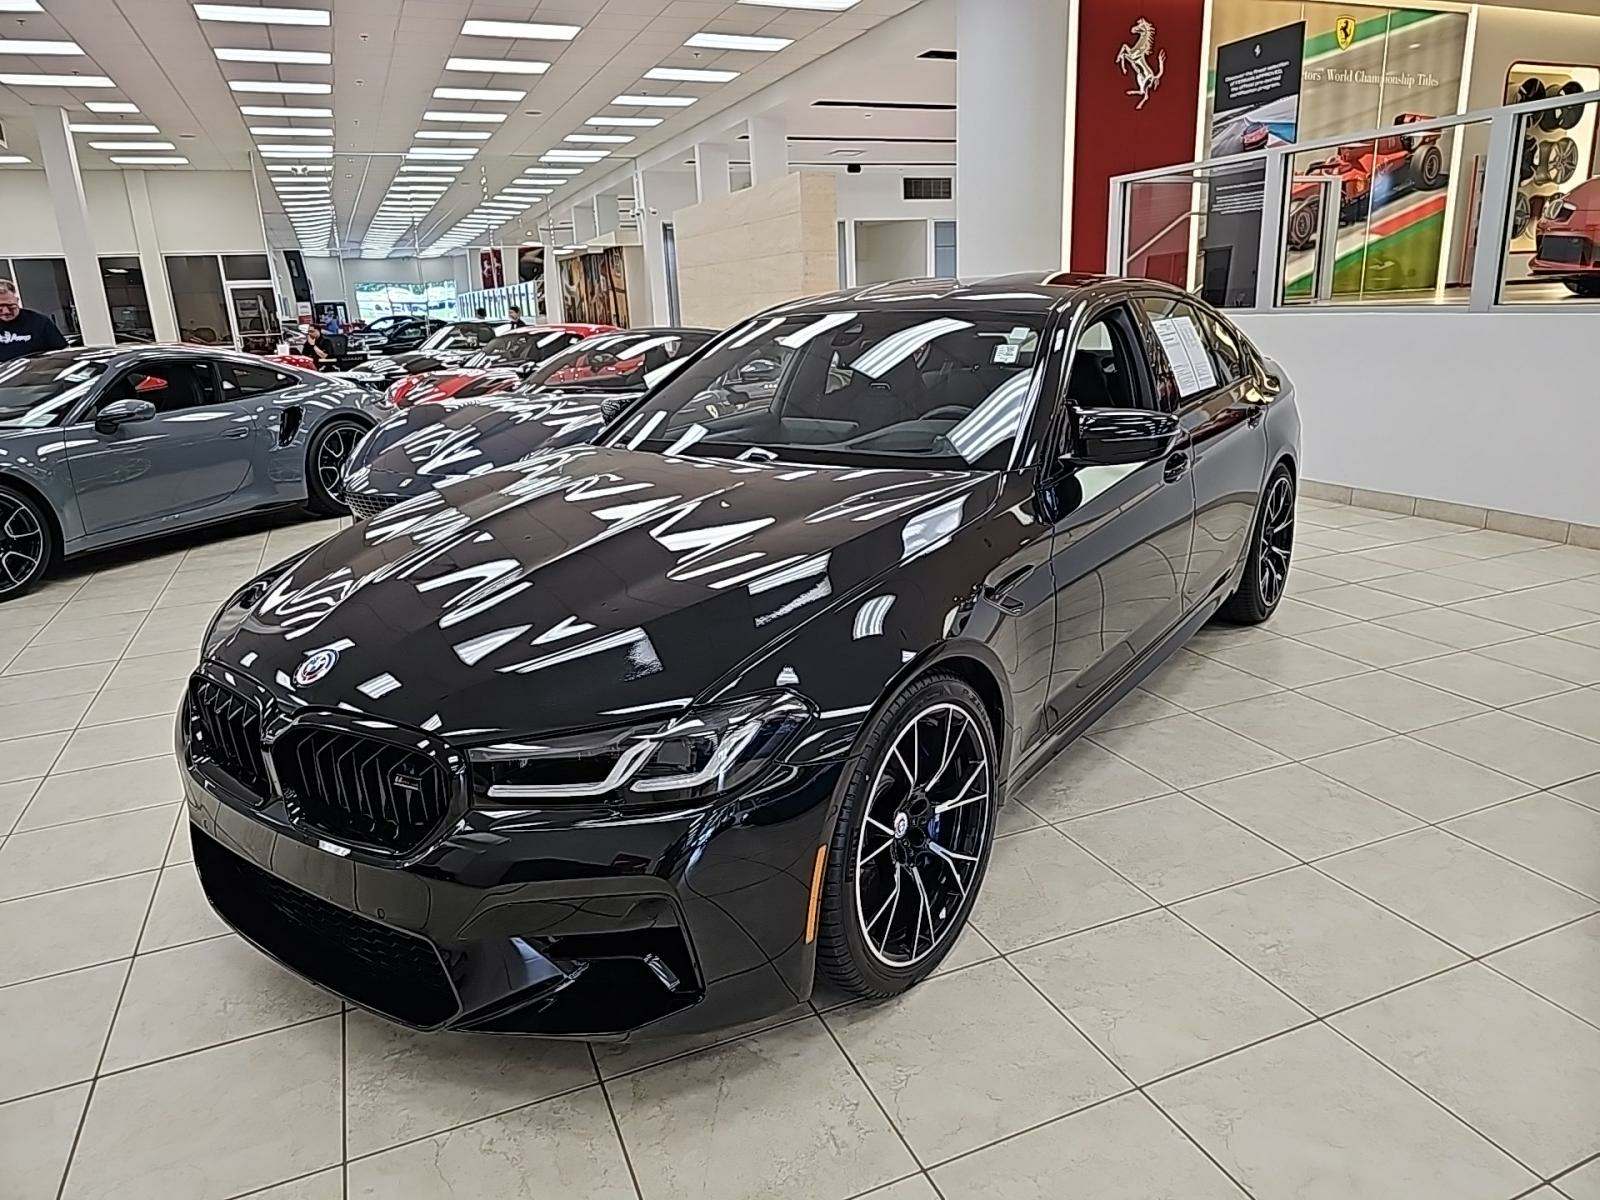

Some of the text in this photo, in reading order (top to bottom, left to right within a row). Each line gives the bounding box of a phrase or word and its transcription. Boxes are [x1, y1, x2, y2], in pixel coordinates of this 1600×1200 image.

[1303, 68, 1324, 81] tors'
[1326, 68, 1353, 83] World
[1417, 73, 1439, 87] Titles
